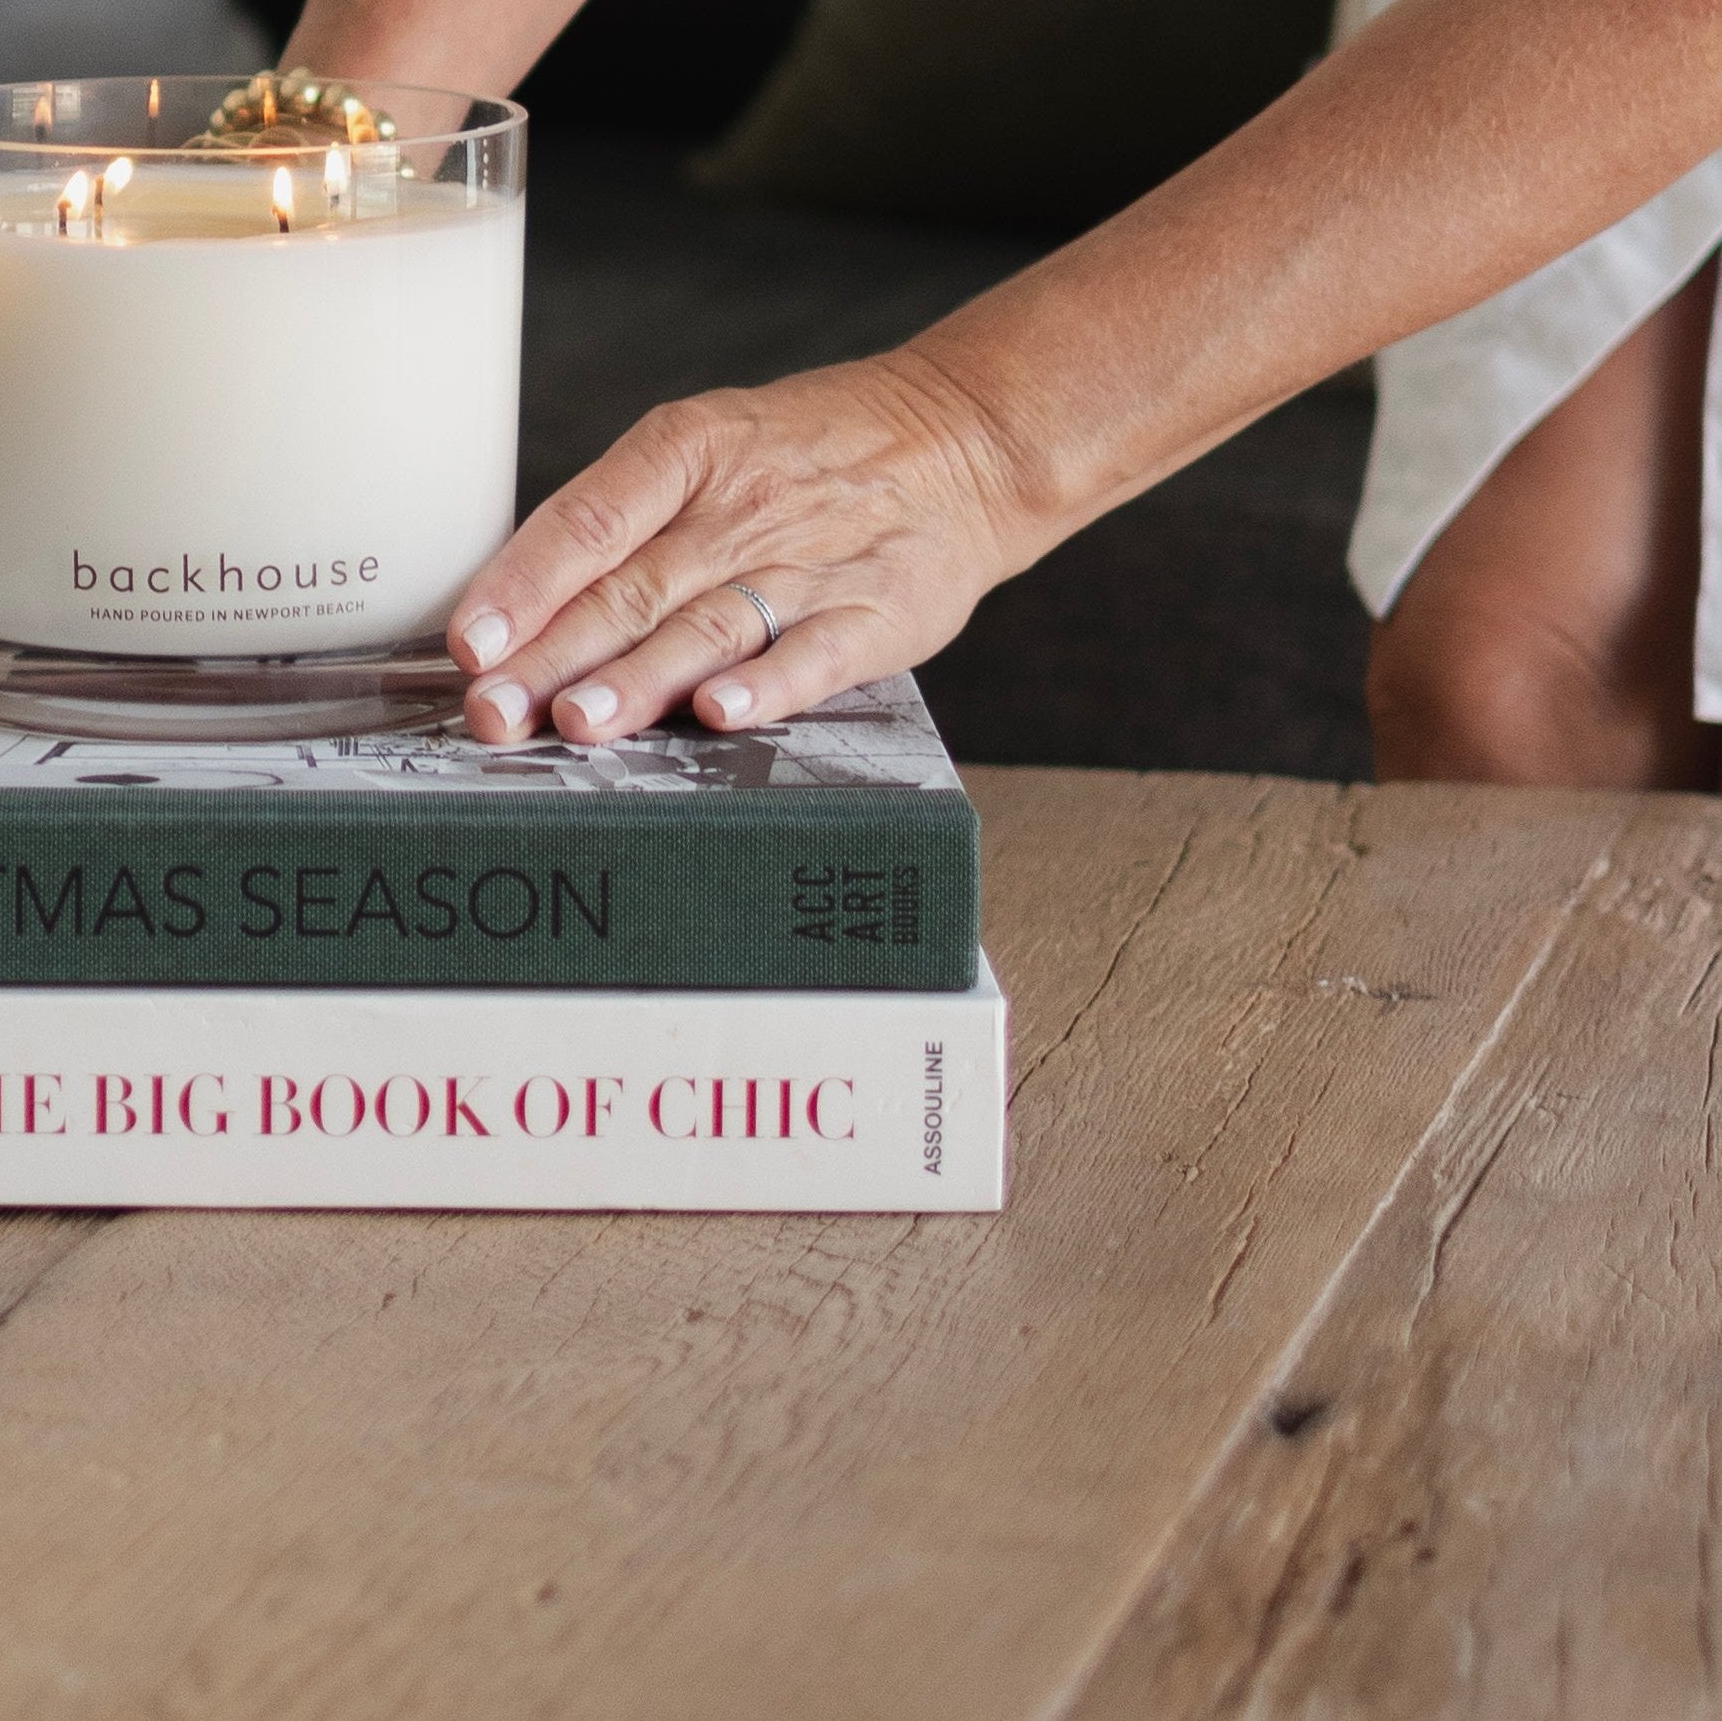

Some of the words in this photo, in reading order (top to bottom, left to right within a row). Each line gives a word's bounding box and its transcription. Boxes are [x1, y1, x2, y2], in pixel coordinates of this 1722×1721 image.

[73, 549, 380, 594] backhouse
[90, 607, 135, 621] HAND
[140, 610, 205, 622] POURED
[211, 610, 227, 622] IN
[233, 605, 311, 621] NEWPORT
[316, 600, 365, 616] BEACH
[239, 866, 611, 940] SEASON
[792, 865, 835, 943] ACC
[842, 865, 886, 943] ART
[892, 864, 920, 944] BOOKS
[88, 1074, 235, 1137] BIG
[252, 1073, 500, 1138] BOOK
[513, 1075, 624, 1139] OF
[648, 1076, 856, 1140] CHIC
[923, 1041, 944, 1176] ASSOULINE
